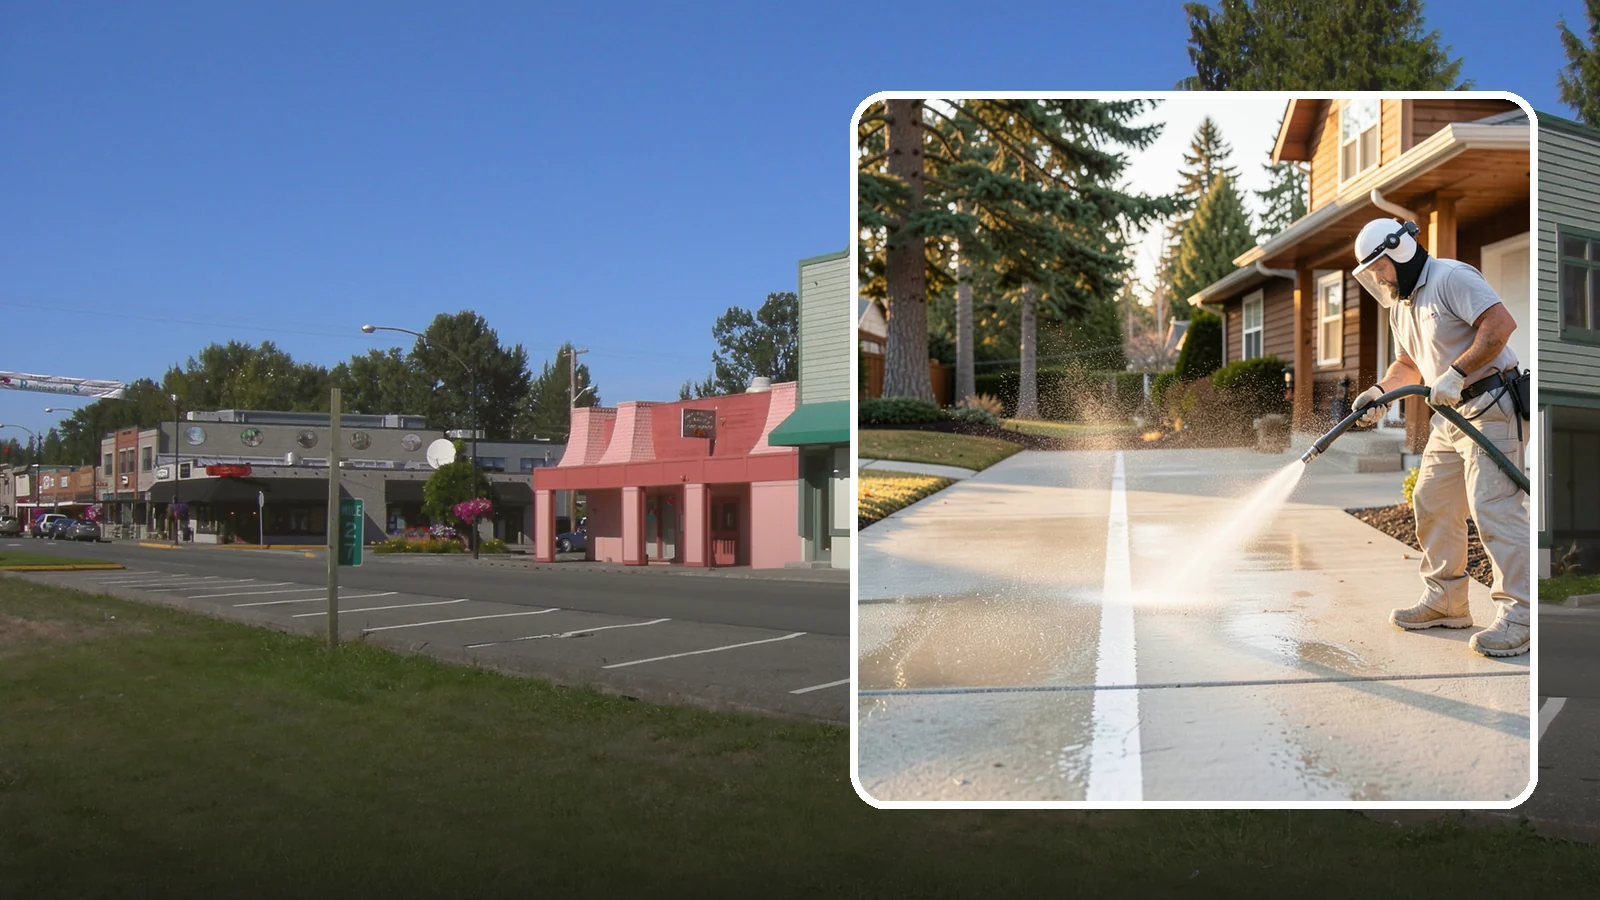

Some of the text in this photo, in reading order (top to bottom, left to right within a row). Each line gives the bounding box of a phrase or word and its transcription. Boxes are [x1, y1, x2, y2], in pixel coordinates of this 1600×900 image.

[341, 505, 361, 516] MILE
[344, 522, 356, 538] 2
[344, 543, 356, 559] 7
